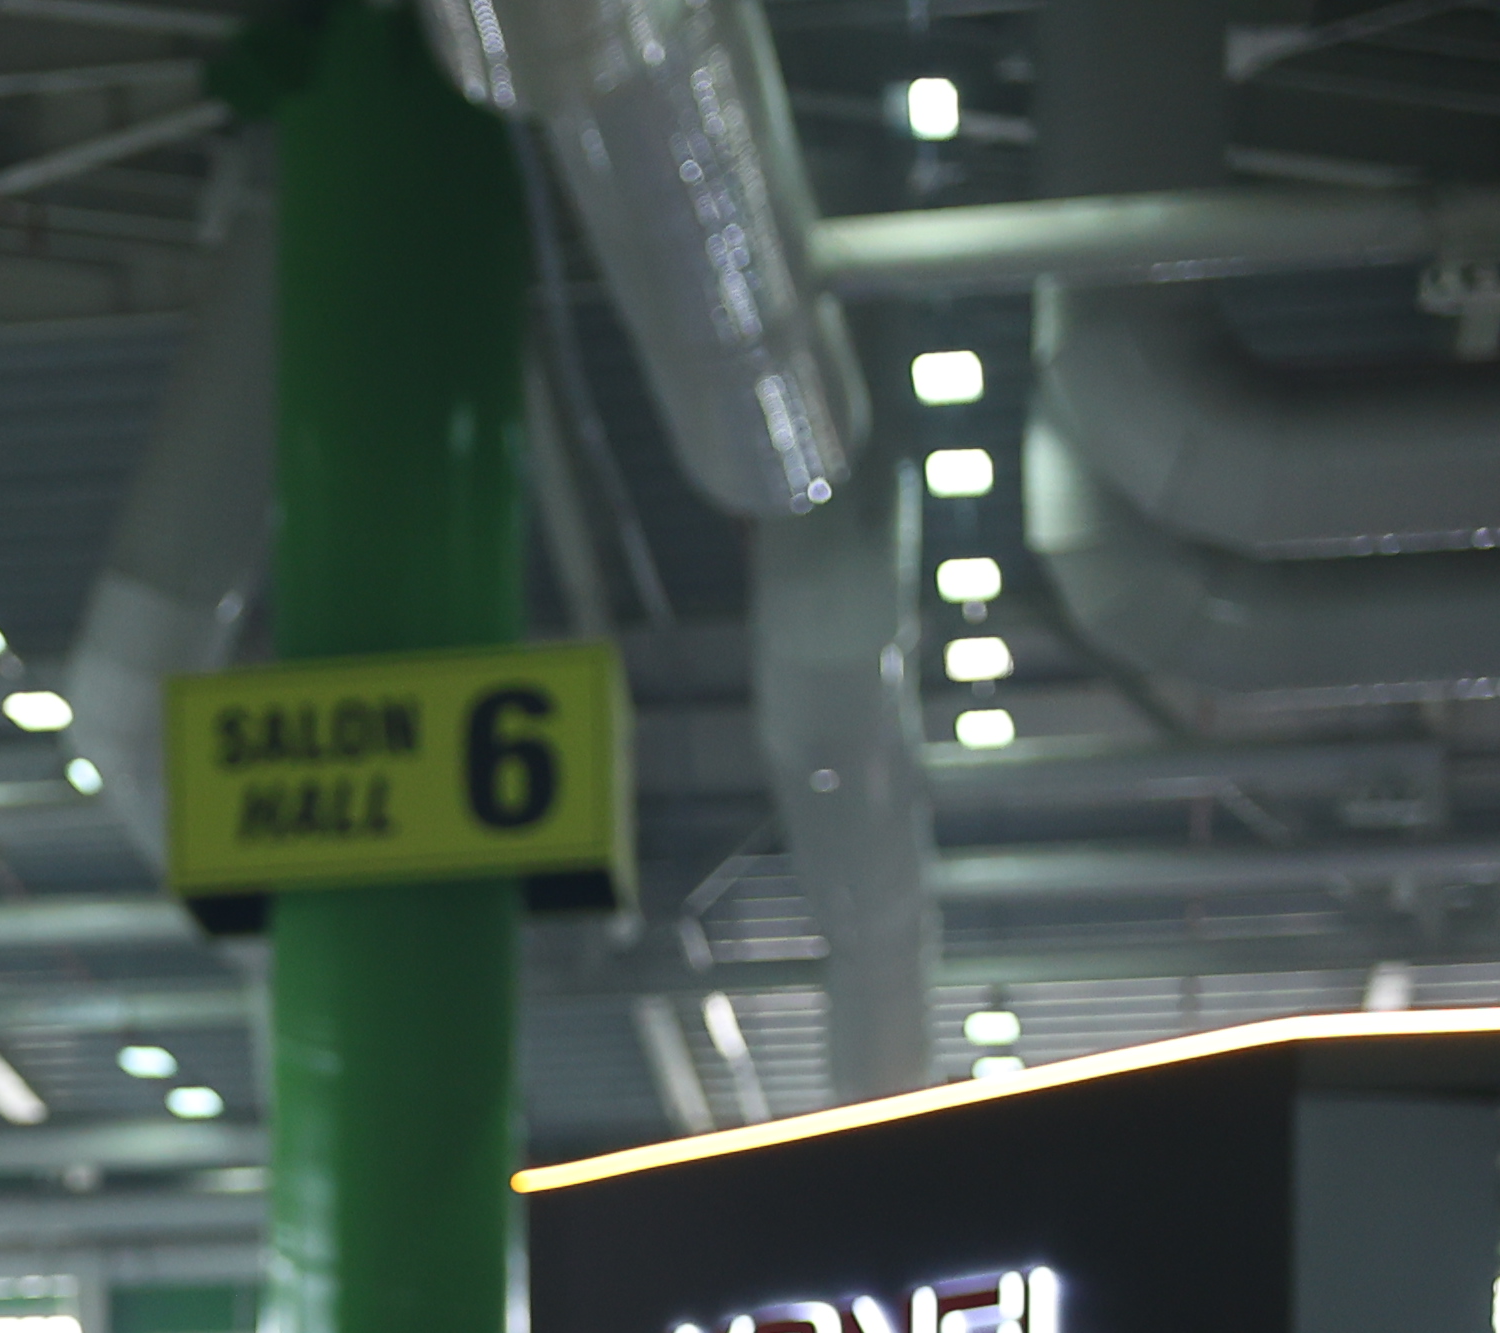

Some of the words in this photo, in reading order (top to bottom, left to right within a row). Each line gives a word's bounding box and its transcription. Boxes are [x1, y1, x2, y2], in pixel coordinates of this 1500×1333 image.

[215, 696, 422, 770] SALON
[462, 682, 561, 833] 6
[237, 775, 391, 846] HALL
